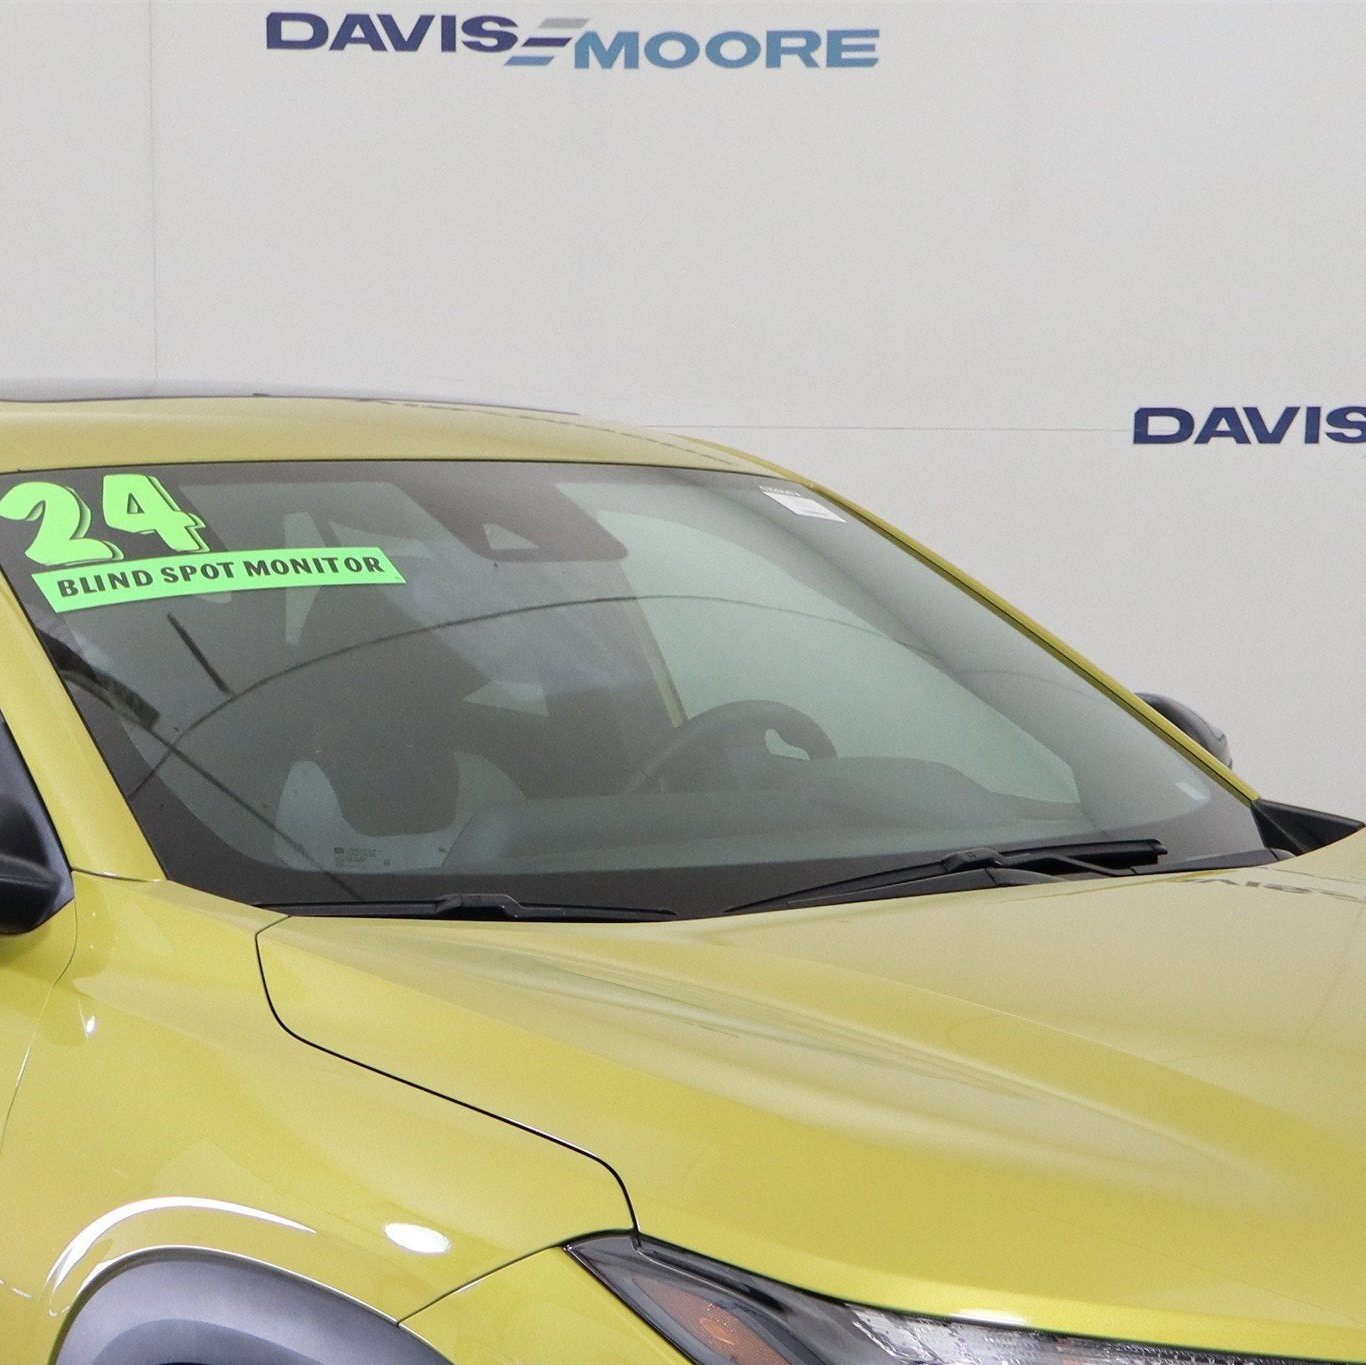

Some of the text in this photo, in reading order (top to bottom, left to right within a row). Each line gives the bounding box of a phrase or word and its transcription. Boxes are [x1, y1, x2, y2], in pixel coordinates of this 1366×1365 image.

[266, 12, 880, 69] DAVIS MOORE
[56, 556, 386, 598] BLIND SPOT MONITOR
